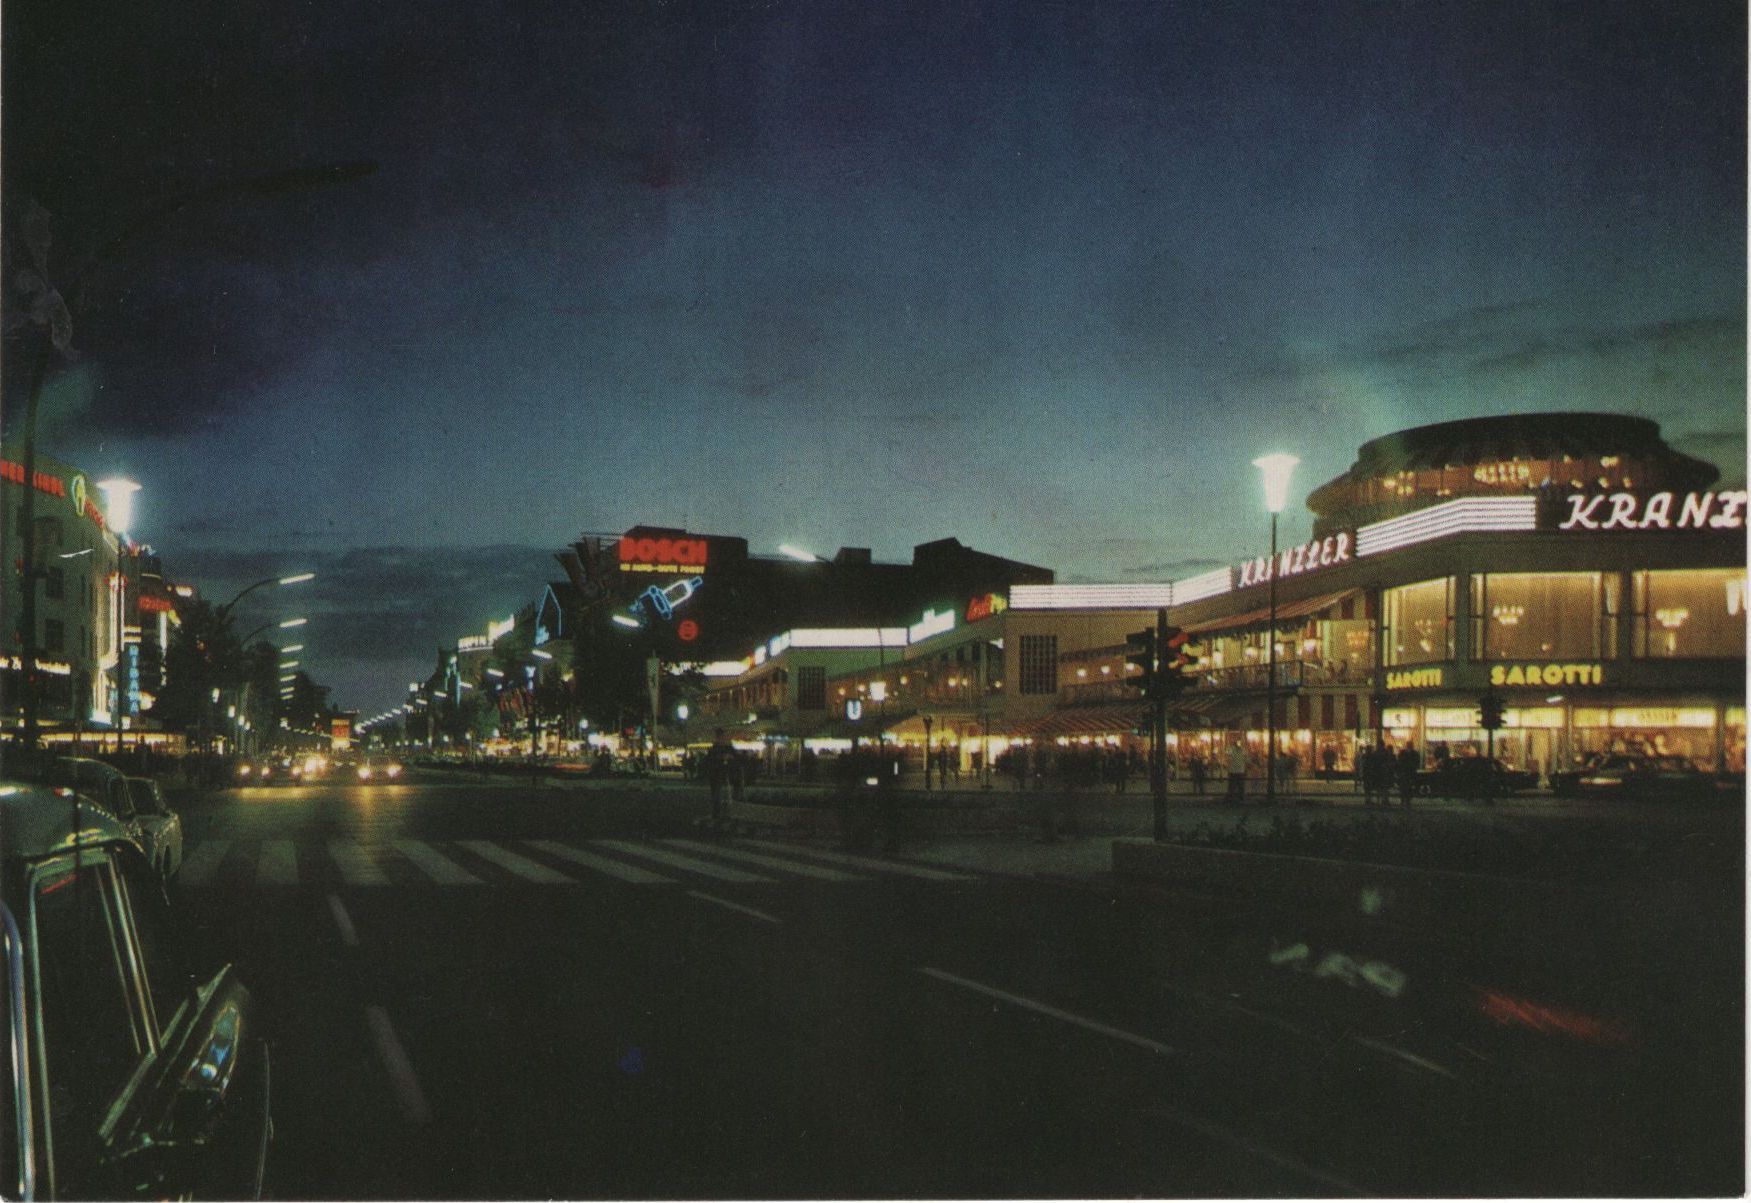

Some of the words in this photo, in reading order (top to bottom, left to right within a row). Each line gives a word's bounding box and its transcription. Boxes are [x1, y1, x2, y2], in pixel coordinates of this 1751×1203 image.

[620, 537, 707, 564] BOSCH
[1386, 668, 1443, 689] SAROTTI
[1490, 664, 1602, 686] SAROTTI
[847, 700, 862, 720] U
